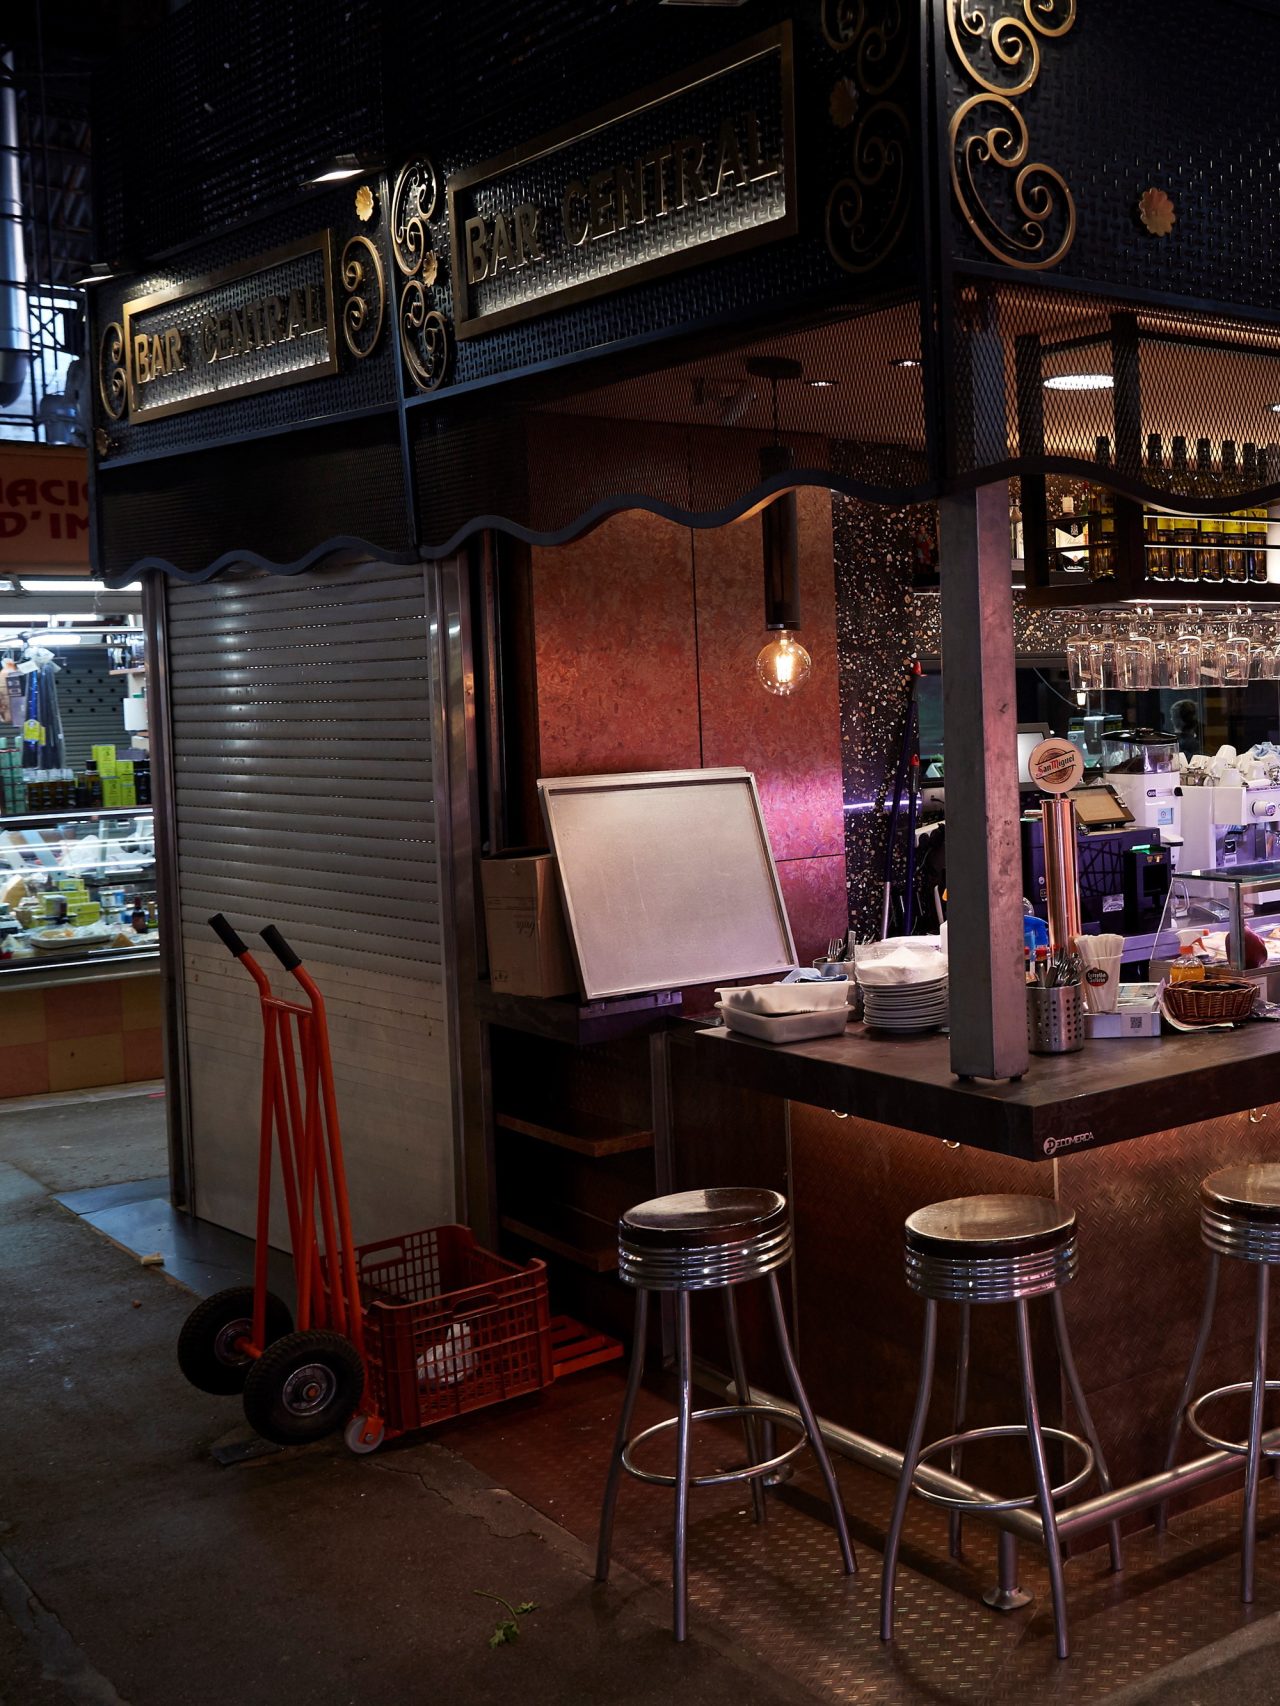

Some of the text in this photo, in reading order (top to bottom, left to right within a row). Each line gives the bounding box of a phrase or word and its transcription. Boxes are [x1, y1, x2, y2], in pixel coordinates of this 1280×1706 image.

[464, 111, 780, 284] BAR CENTRAL
[134, 284, 327, 384] BAR CENTRAL
[0, 478, 89, 507] ACI
